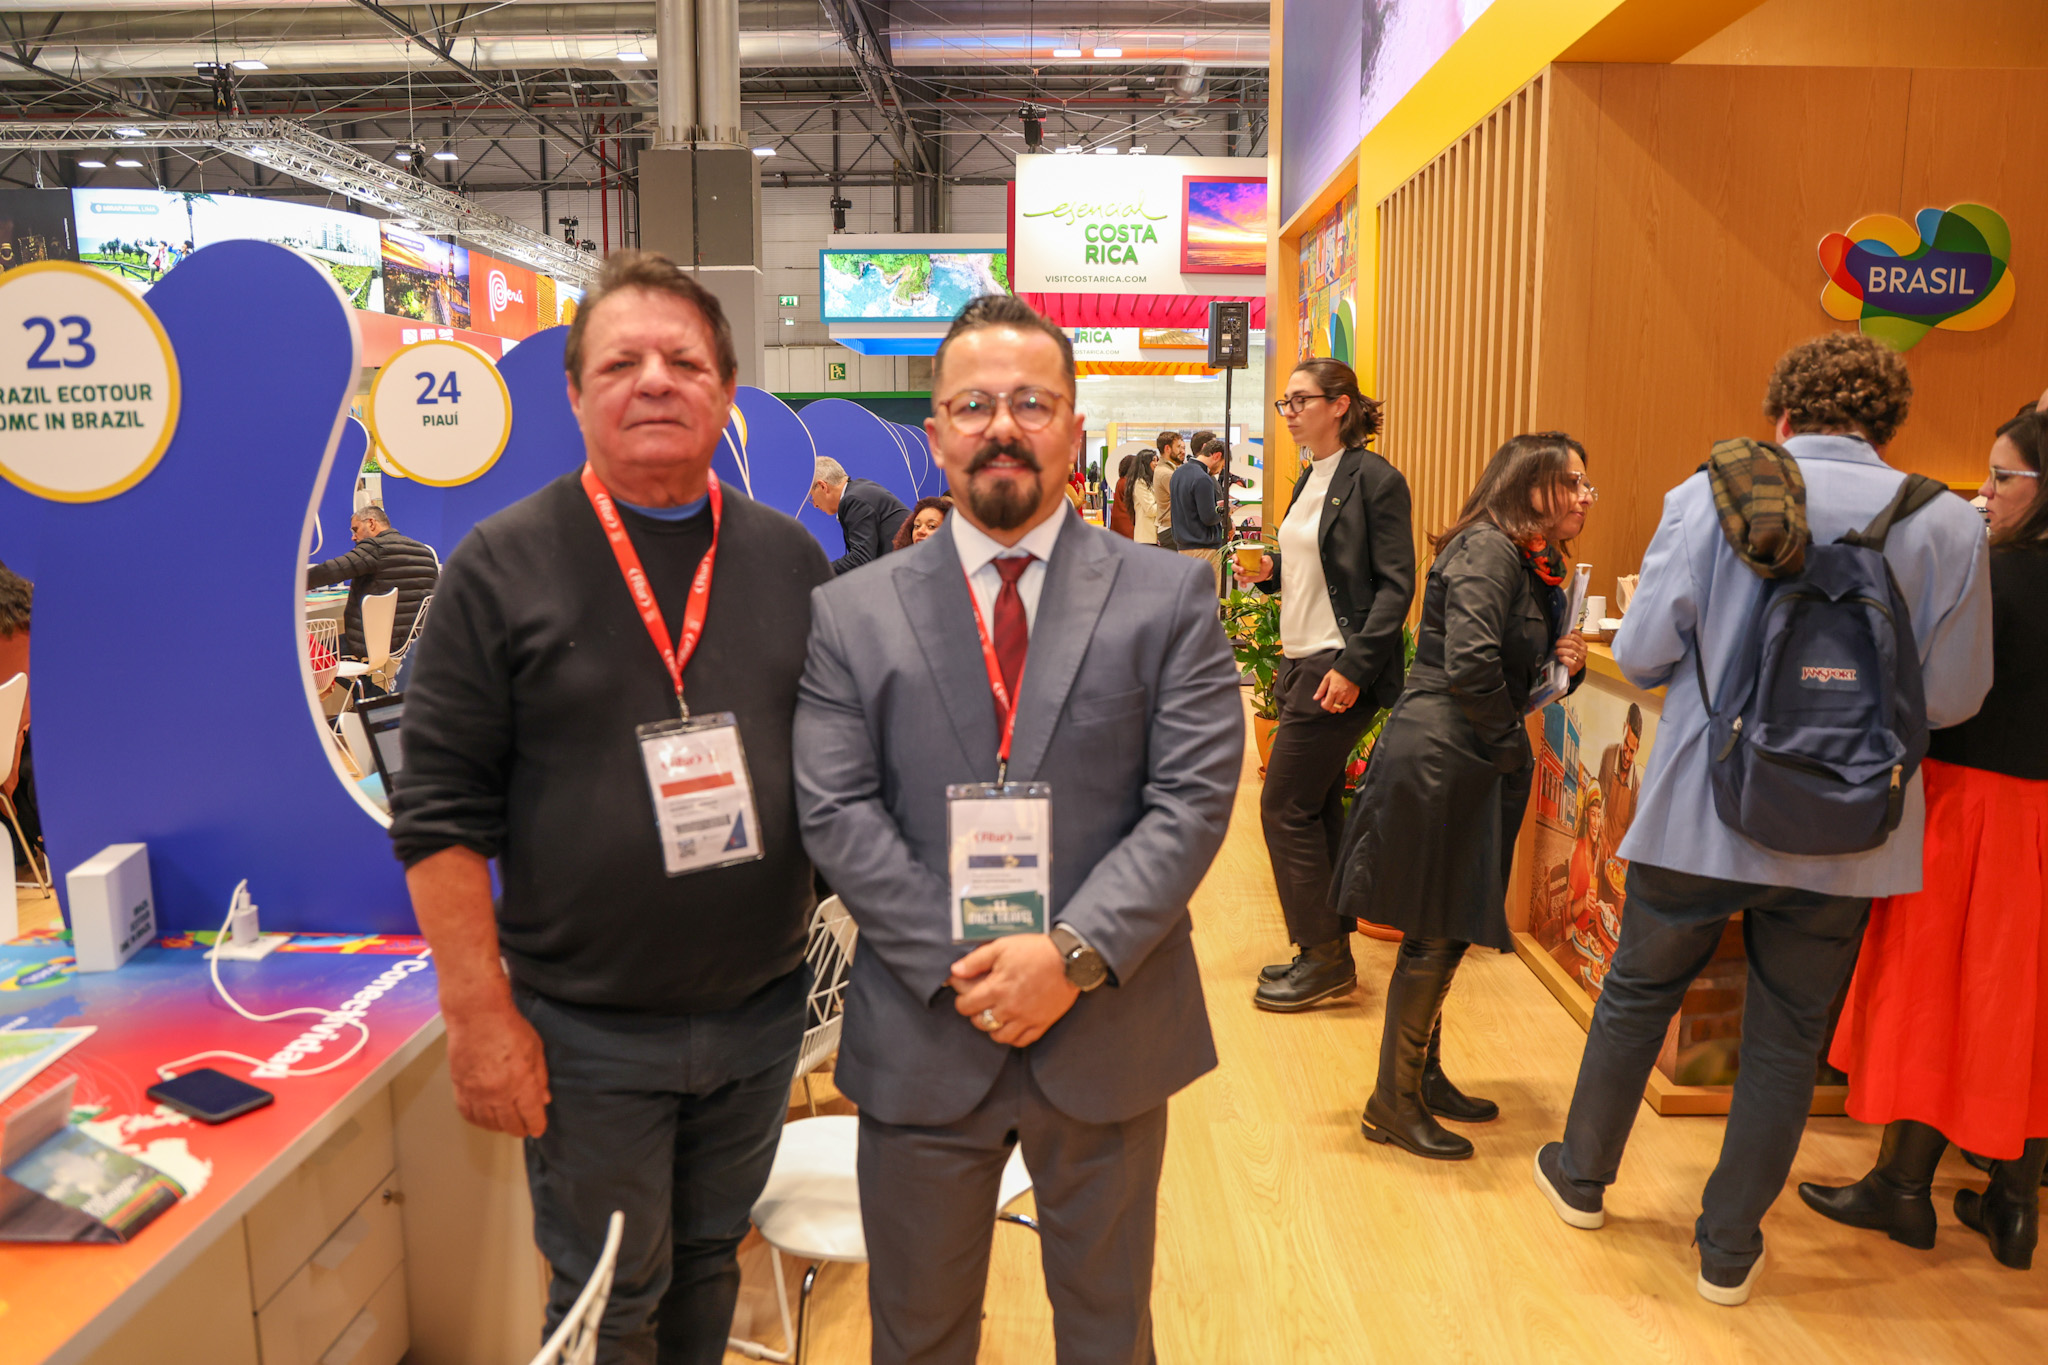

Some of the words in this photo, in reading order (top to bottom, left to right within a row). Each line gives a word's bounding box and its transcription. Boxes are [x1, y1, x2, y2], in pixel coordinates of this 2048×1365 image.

[1023, 190, 1167, 225] esencial
[1085, 223, 1158, 244] COSTA
[1085, 244, 1139, 265] RICA
[1045, 275, 1147, 283] VISITCOSTARICA.COM
[1868, 266, 1975, 294] BRASIL
[488, 270, 524, 322] Perú
[22, 315, 96, 369] 23
[1080, 331, 1113, 343] RICA
[57, 384, 152, 403] ECOTOUR
[414, 371, 462, 405] 24
[45, 413, 66, 430] IN
[72, 411, 144, 429] BRAZIL
[422, 411, 459, 427] PIAUÍ
[1801, 666, 1857, 682] JANSPORT
